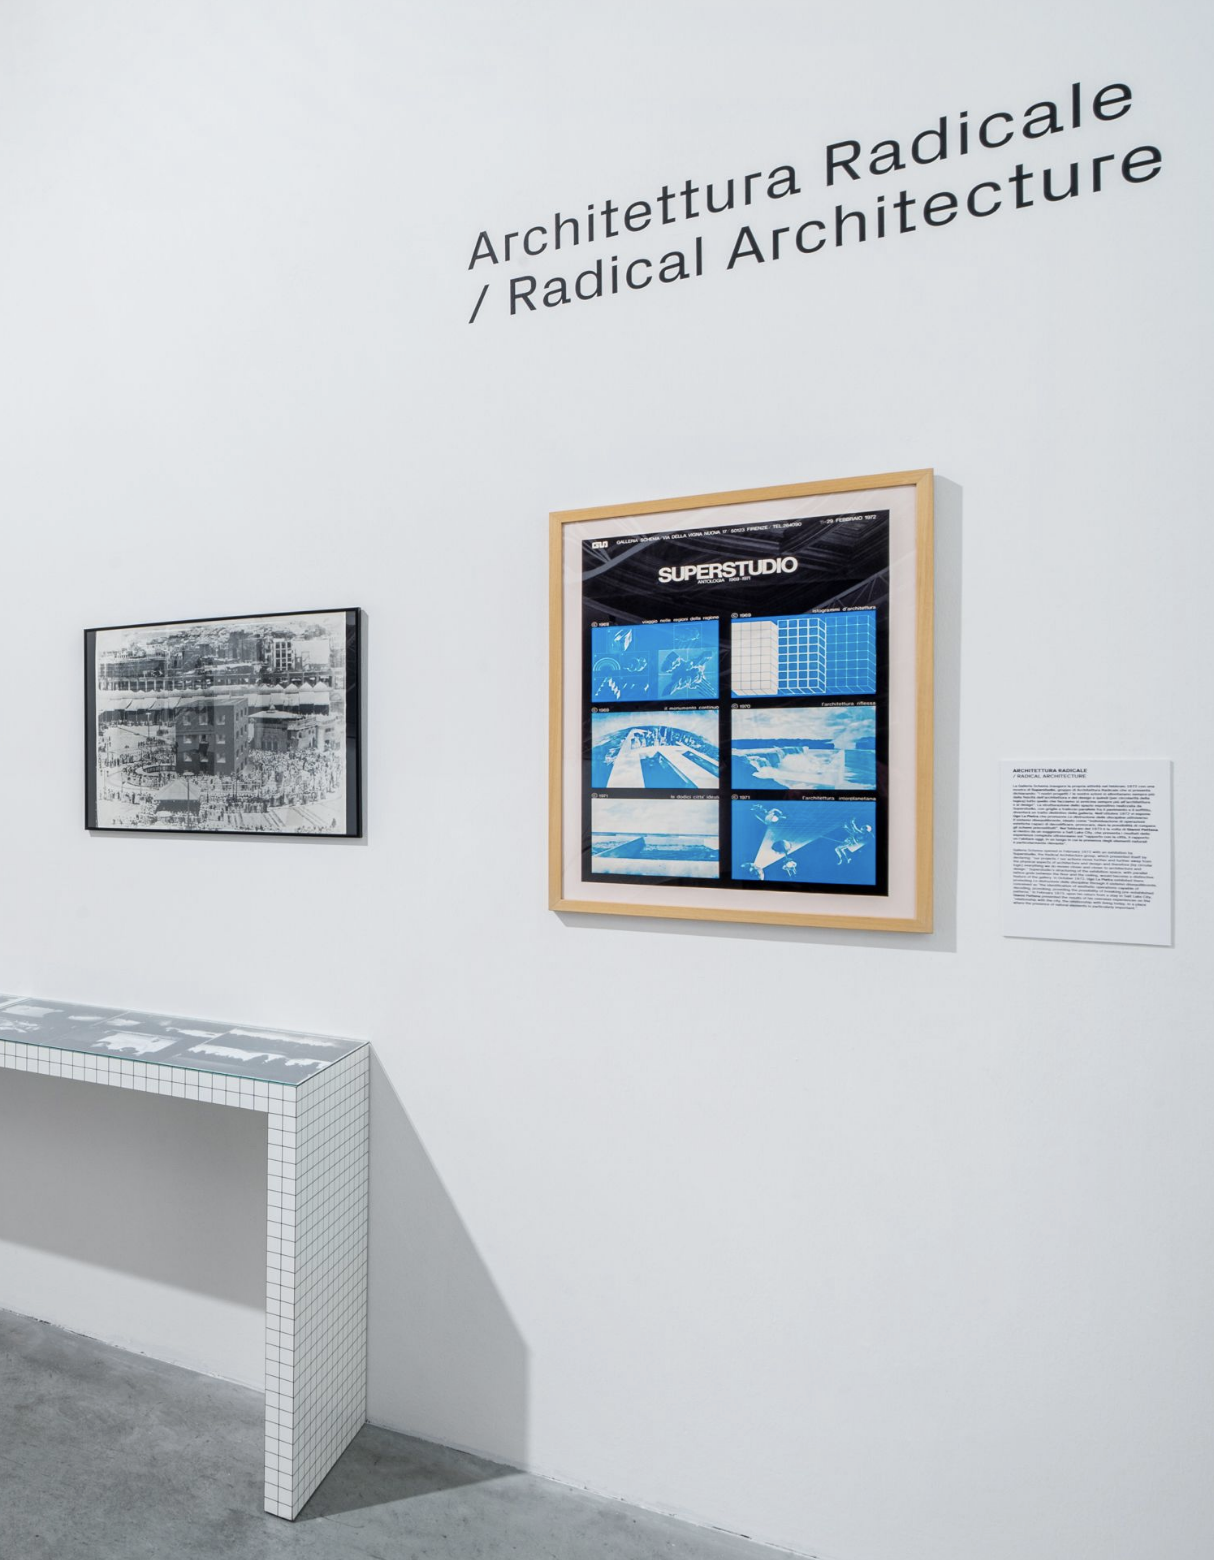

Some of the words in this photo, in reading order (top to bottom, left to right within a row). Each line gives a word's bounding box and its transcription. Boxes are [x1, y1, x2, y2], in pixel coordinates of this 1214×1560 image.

[468, 165, 801, 271] Architettura
[826, 82, 1133, 187] Radicale
[468, 284, 490, 324] /
[509, 236, 703, 316] Radical
[726, 145, 1162, 270] Architecture
[658, 556, 798, 583] SUPERSTUDIO
